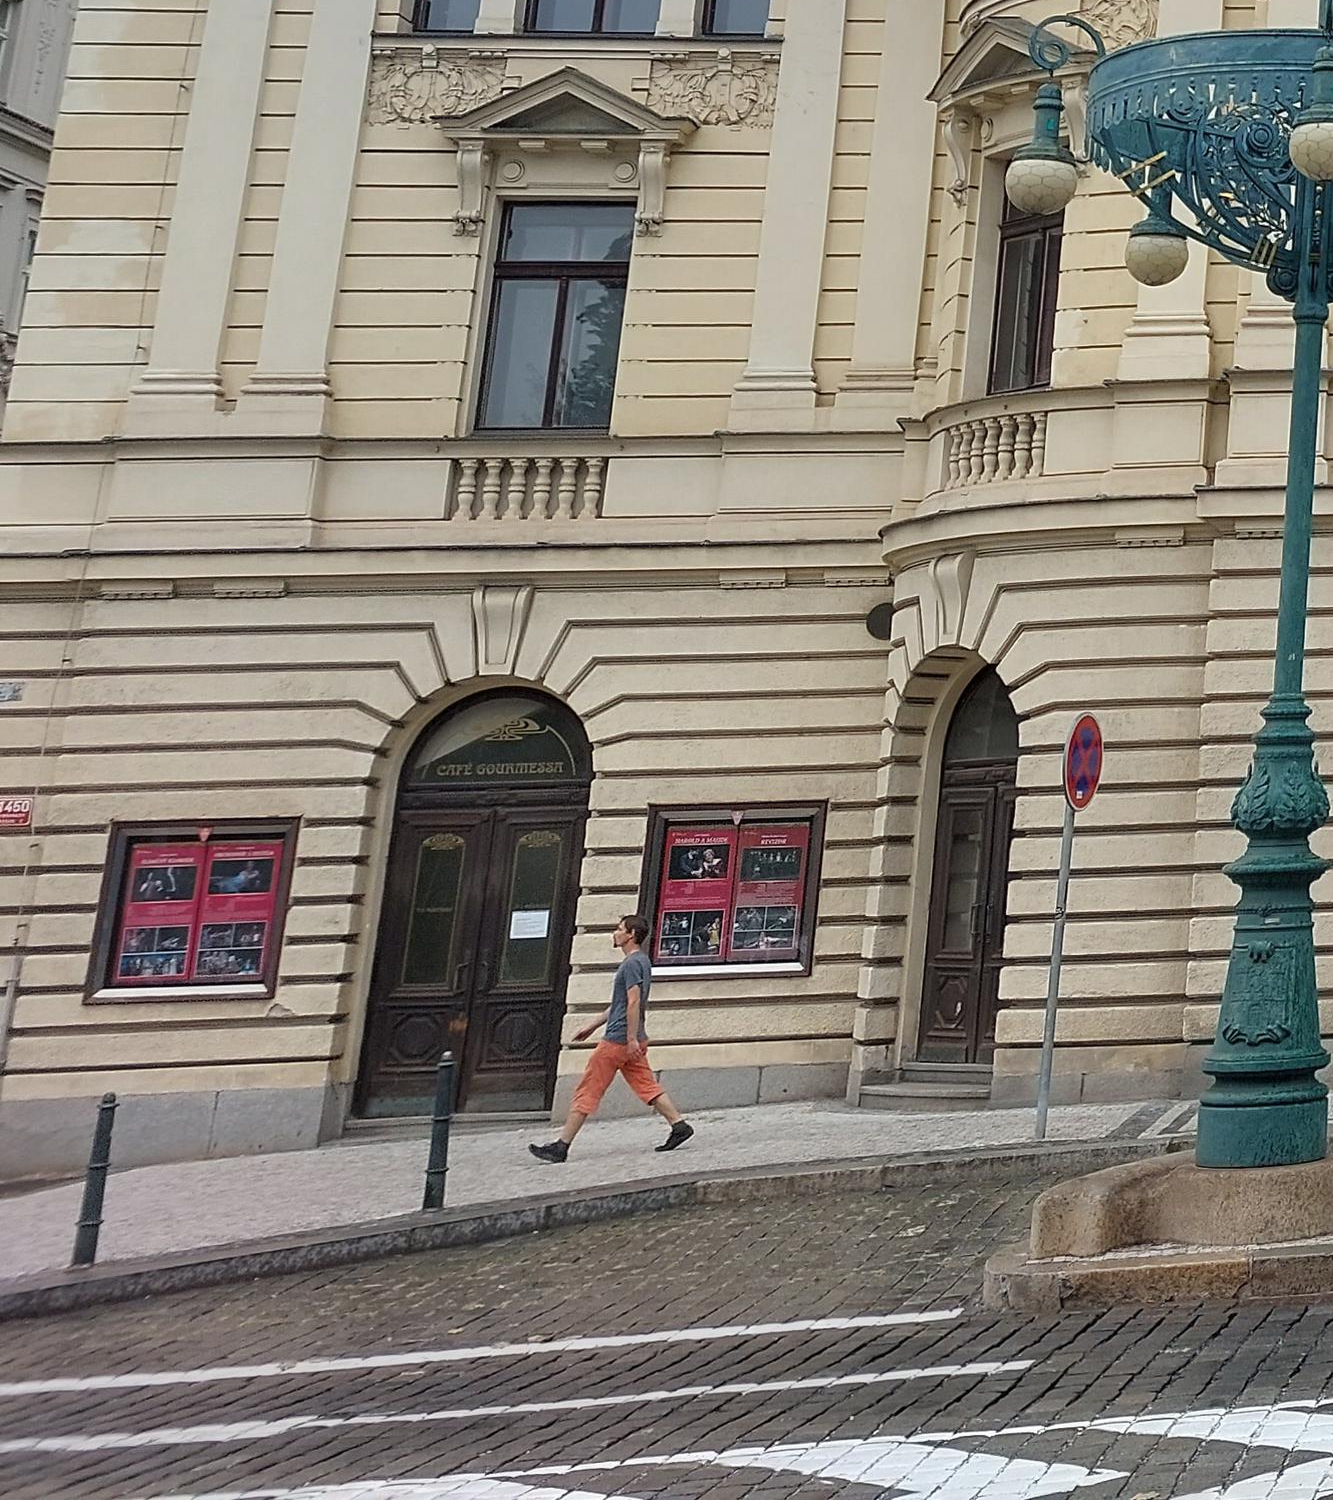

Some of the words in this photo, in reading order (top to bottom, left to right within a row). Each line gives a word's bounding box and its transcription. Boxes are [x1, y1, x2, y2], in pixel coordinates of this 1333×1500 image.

[436, 762, 473, 776] CAFÉ
[476, 762, 564, 775] GOURMESSA
[0, 800, 30, 813] 1450
